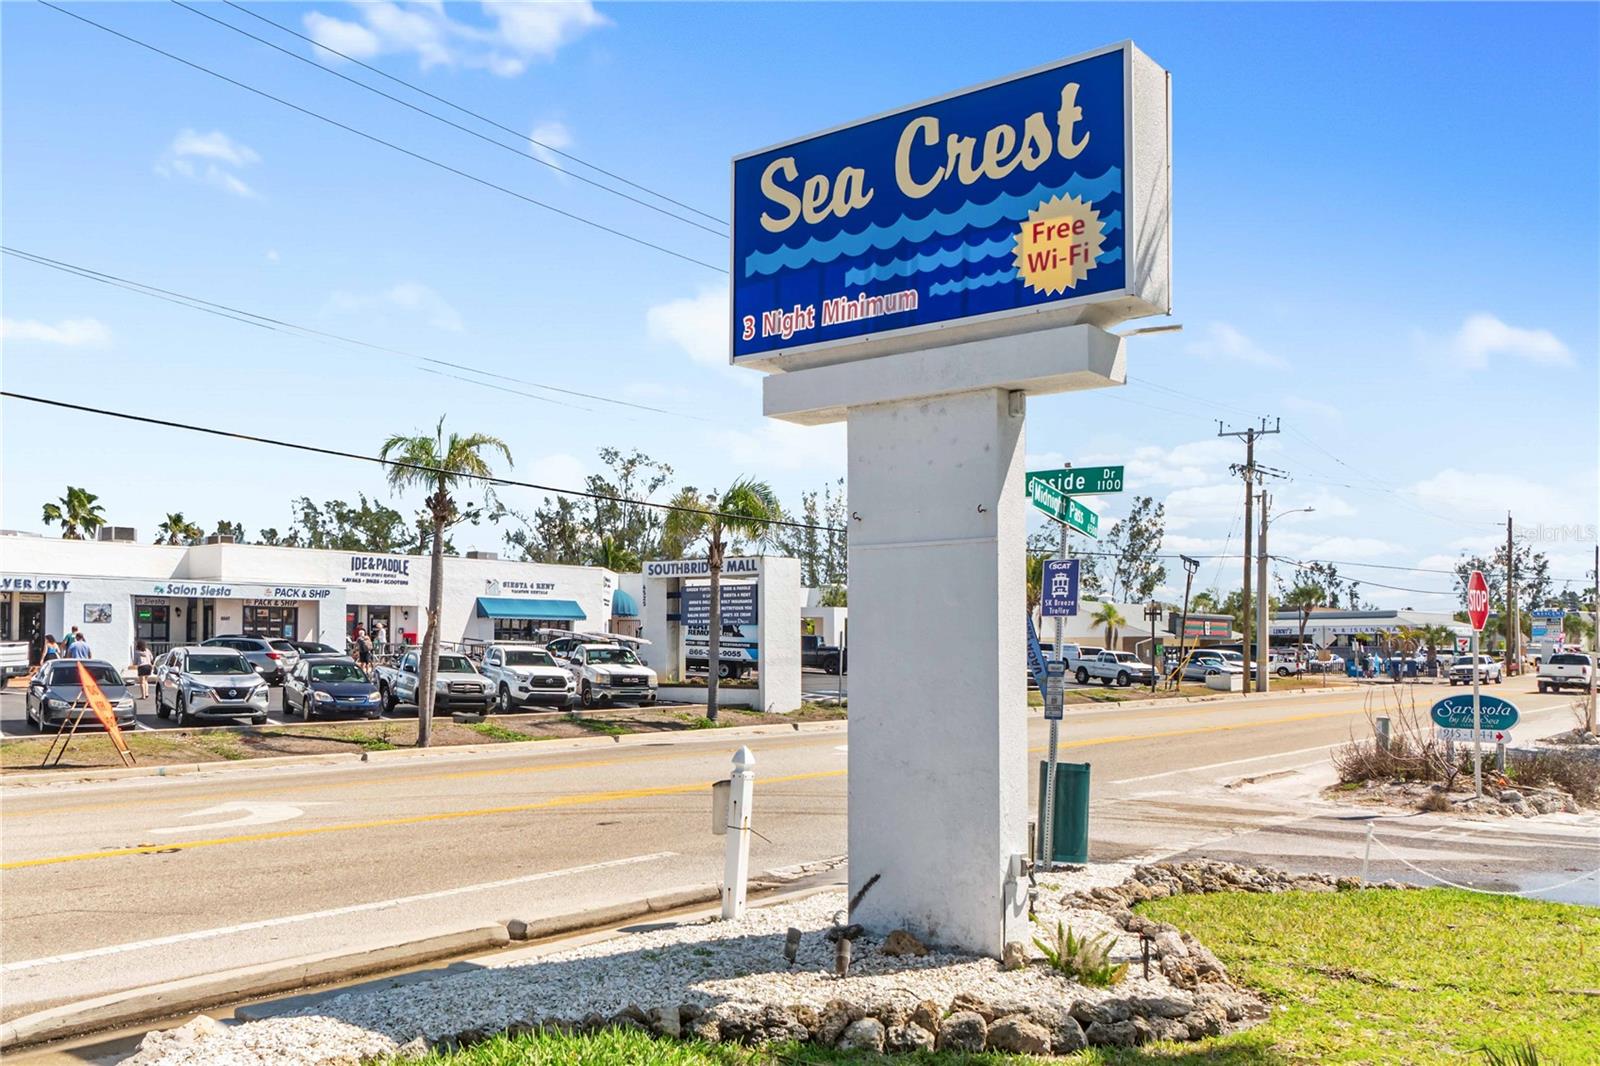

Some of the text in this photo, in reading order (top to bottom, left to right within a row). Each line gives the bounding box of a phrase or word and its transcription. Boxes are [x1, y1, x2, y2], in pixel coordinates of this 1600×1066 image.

[760, 82, 1090, 233] Sea Crest
[1032, 217, 1085, 244] Free
[1027, 241, 1089, 273] Wi-Fi
[742, 288, 918, 340] 3 Night Minimum
[1103, 468, 1116, 479] Dr
[1097, 480, 1121, 491] 1100
[1034, 482, 1084, 525] Midnight Pass
[727, 559, 757, 573] MALL
[1050, 561, 1073, 570] SCAT
[0, 578, 70, 590] VER CITY
[166, 583, 231, 596] Salon Siesta
[274, 587, 330, 599] PACK & SHIP
[254, 599, 272, 607] PACK
[281, 599, 298, 607] SHIP
[1054, 599, 1075, 607] Breeze
[1469, 589, 1487, 612] STOP
[1049, 607, 1070, 616] Trolley
[1448, 713, 1460, 725] by
[1480, 713, 1500, 725] Sea
